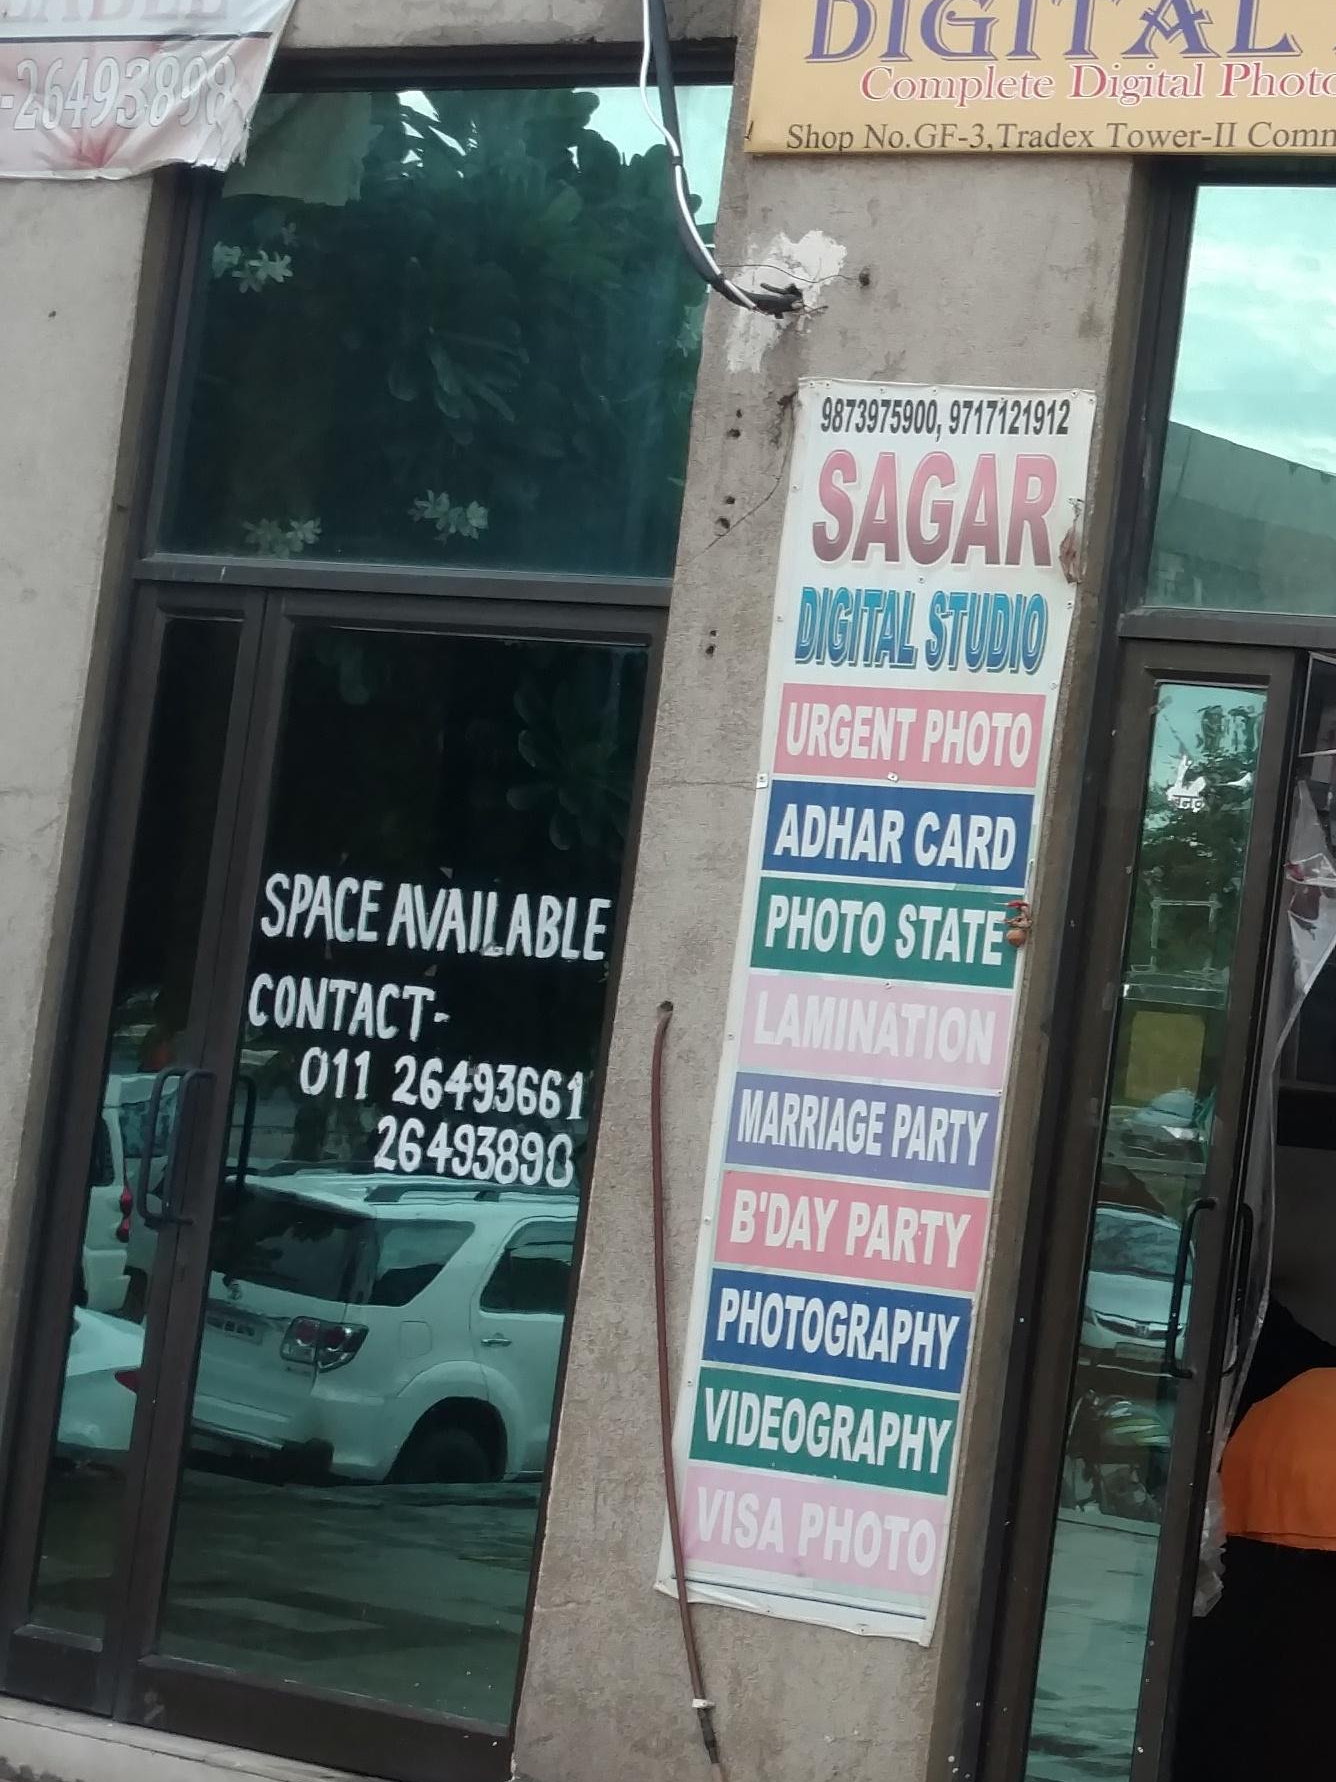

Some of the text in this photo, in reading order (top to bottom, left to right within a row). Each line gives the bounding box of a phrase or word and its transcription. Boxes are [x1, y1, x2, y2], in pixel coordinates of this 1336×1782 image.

[860, 64, 1054, 108] Complete
[1070, 62, 1204, 107] Digital
[785, 124, 855, 153] Shop
[1106, 121, 1237, 149] Tower-II
[820, 397, 1071, 443] 9873975900, 9717121912
[810, 448, 1060, 569] SAGAR
[793, 586, 1049, 676] DIGITAL STUDIO
[785, 702, 1034, 770] URGENT PHOTO
[773, 803, 1018, 872] ADHAR CARD
[261, 872, 613, 961] SPACE AVAILABLE
[764, 894, 1007, 966] PHOTO STATE
[752, 988, 997, 1067] LAMINATION
[300, 1046, 584, 1121] 011 26493661
[736, 1087, 989, 1168] MARRIAGE PARTY
[729, 1188, 972, 1269] B'DAY PARTY
[716, 1286, 960, 1372] PHOTOGRAPHY
[704, 1387, 953, 1474] VIDEOGRAPHY
[697, 1486, 938, 1577] VISA PHOTO
